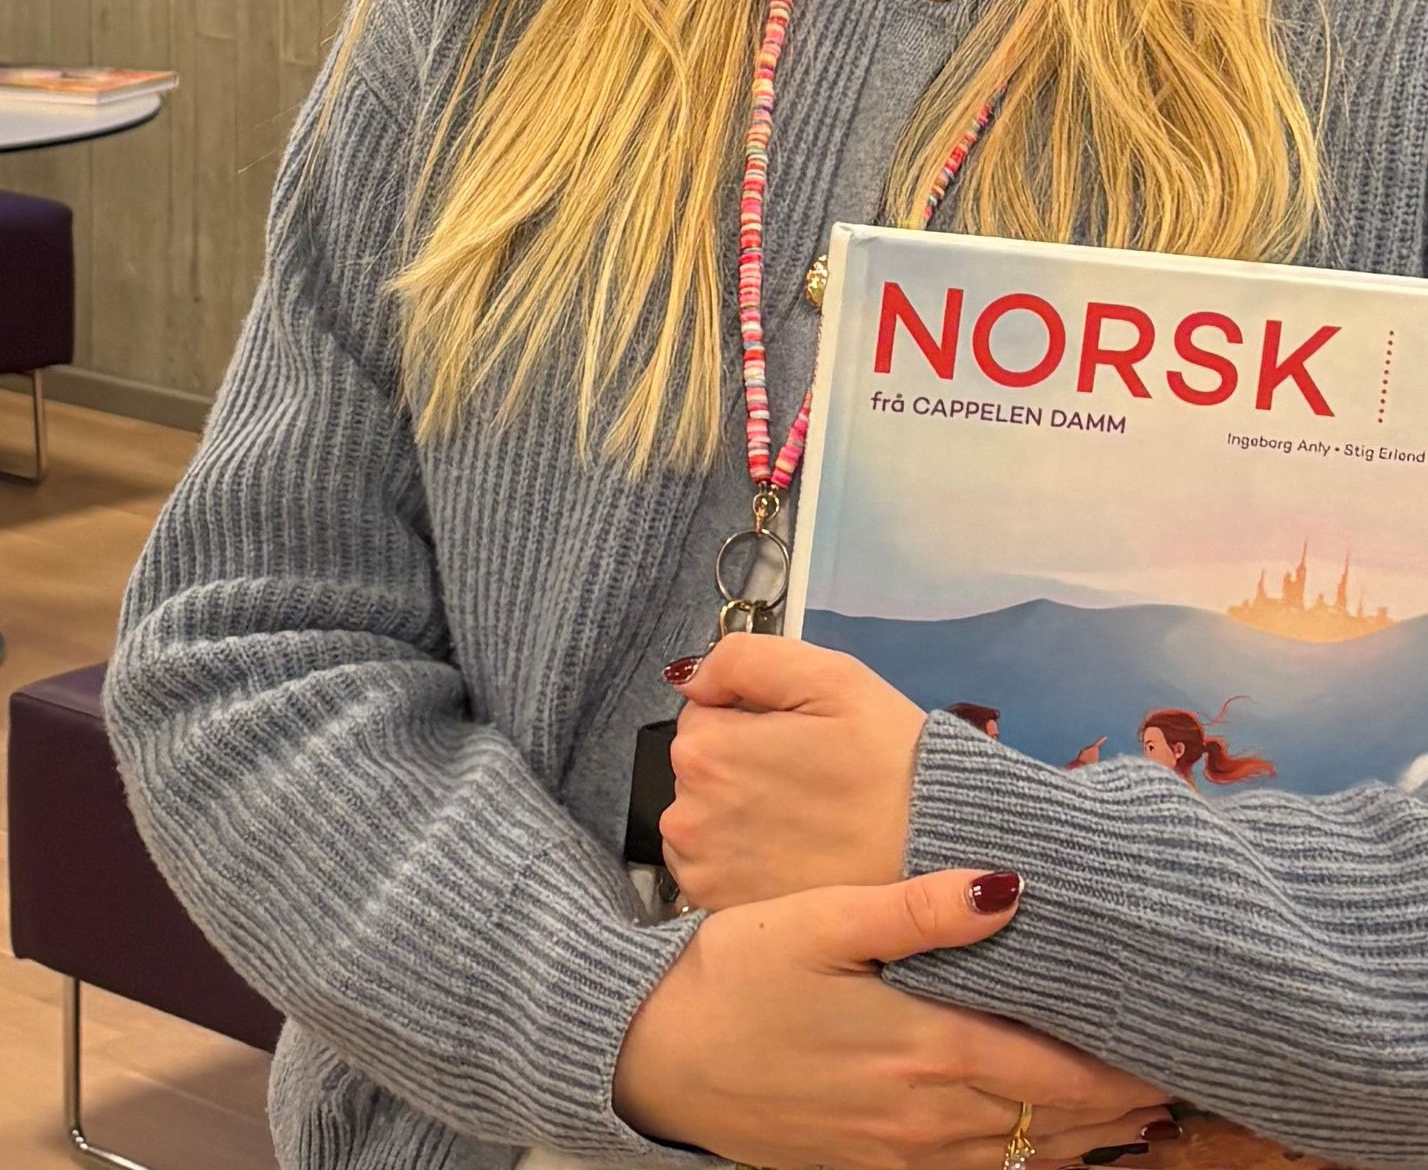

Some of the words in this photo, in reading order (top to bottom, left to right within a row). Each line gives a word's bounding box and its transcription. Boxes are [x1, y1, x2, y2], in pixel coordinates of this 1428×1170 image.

[873, 281, 1342, 419] NORSK
[870, 391, 904, 413] frå
[913, 396, 1042, 426] CAPPELEN
[1050, 409, 1127, 434] DAMM
[1227, 432, 1293, 454] Ingeborg
[1344, 443, 1375, 462] Stig
[1379, 447, 1426, 464] Erland
